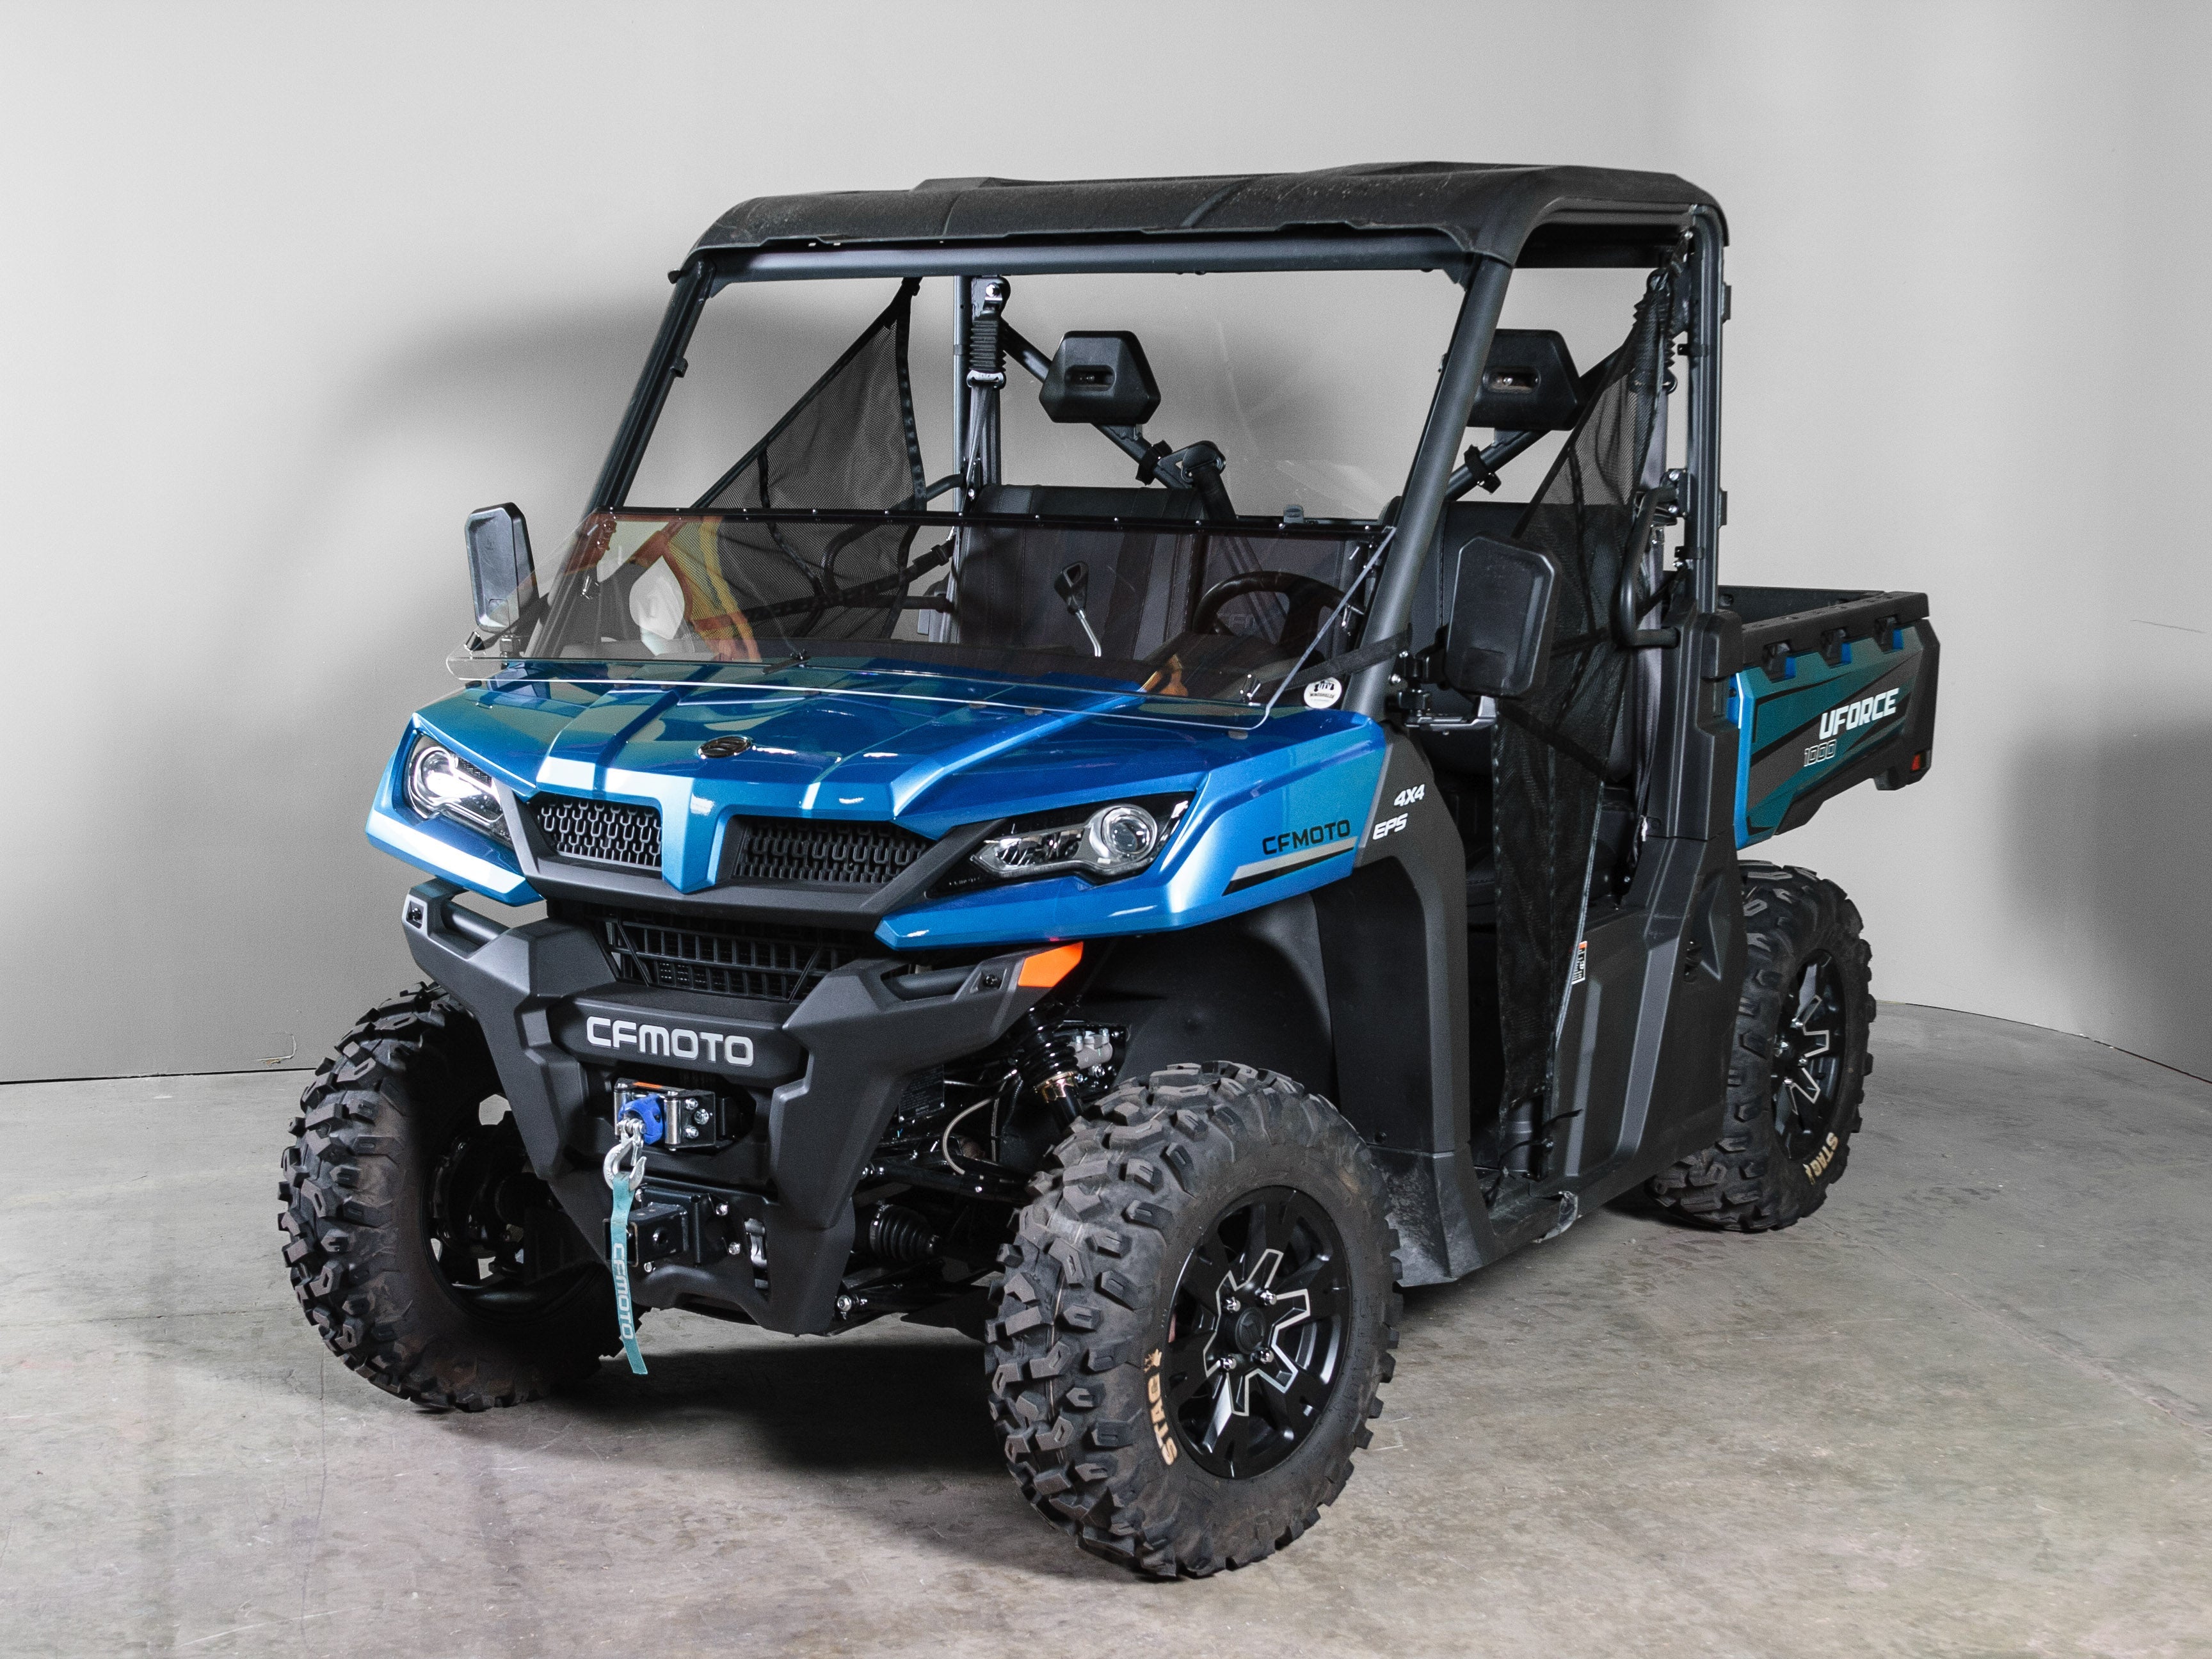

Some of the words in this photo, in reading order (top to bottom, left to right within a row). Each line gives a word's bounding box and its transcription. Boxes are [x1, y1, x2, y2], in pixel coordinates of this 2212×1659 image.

[1819, 687, 1900, 740] UFORCE
[1804, 739, 1836, 767] 1000
[1393, 784, 1425, 806] 4X4
[1262, 819, 1350, 855] CFMOTO
[1372, 813, 1408, 840] EPS
[587, 1016, 753, 1067] CFMOTO
[613, 1242, 634, 1340] CFMOTO
